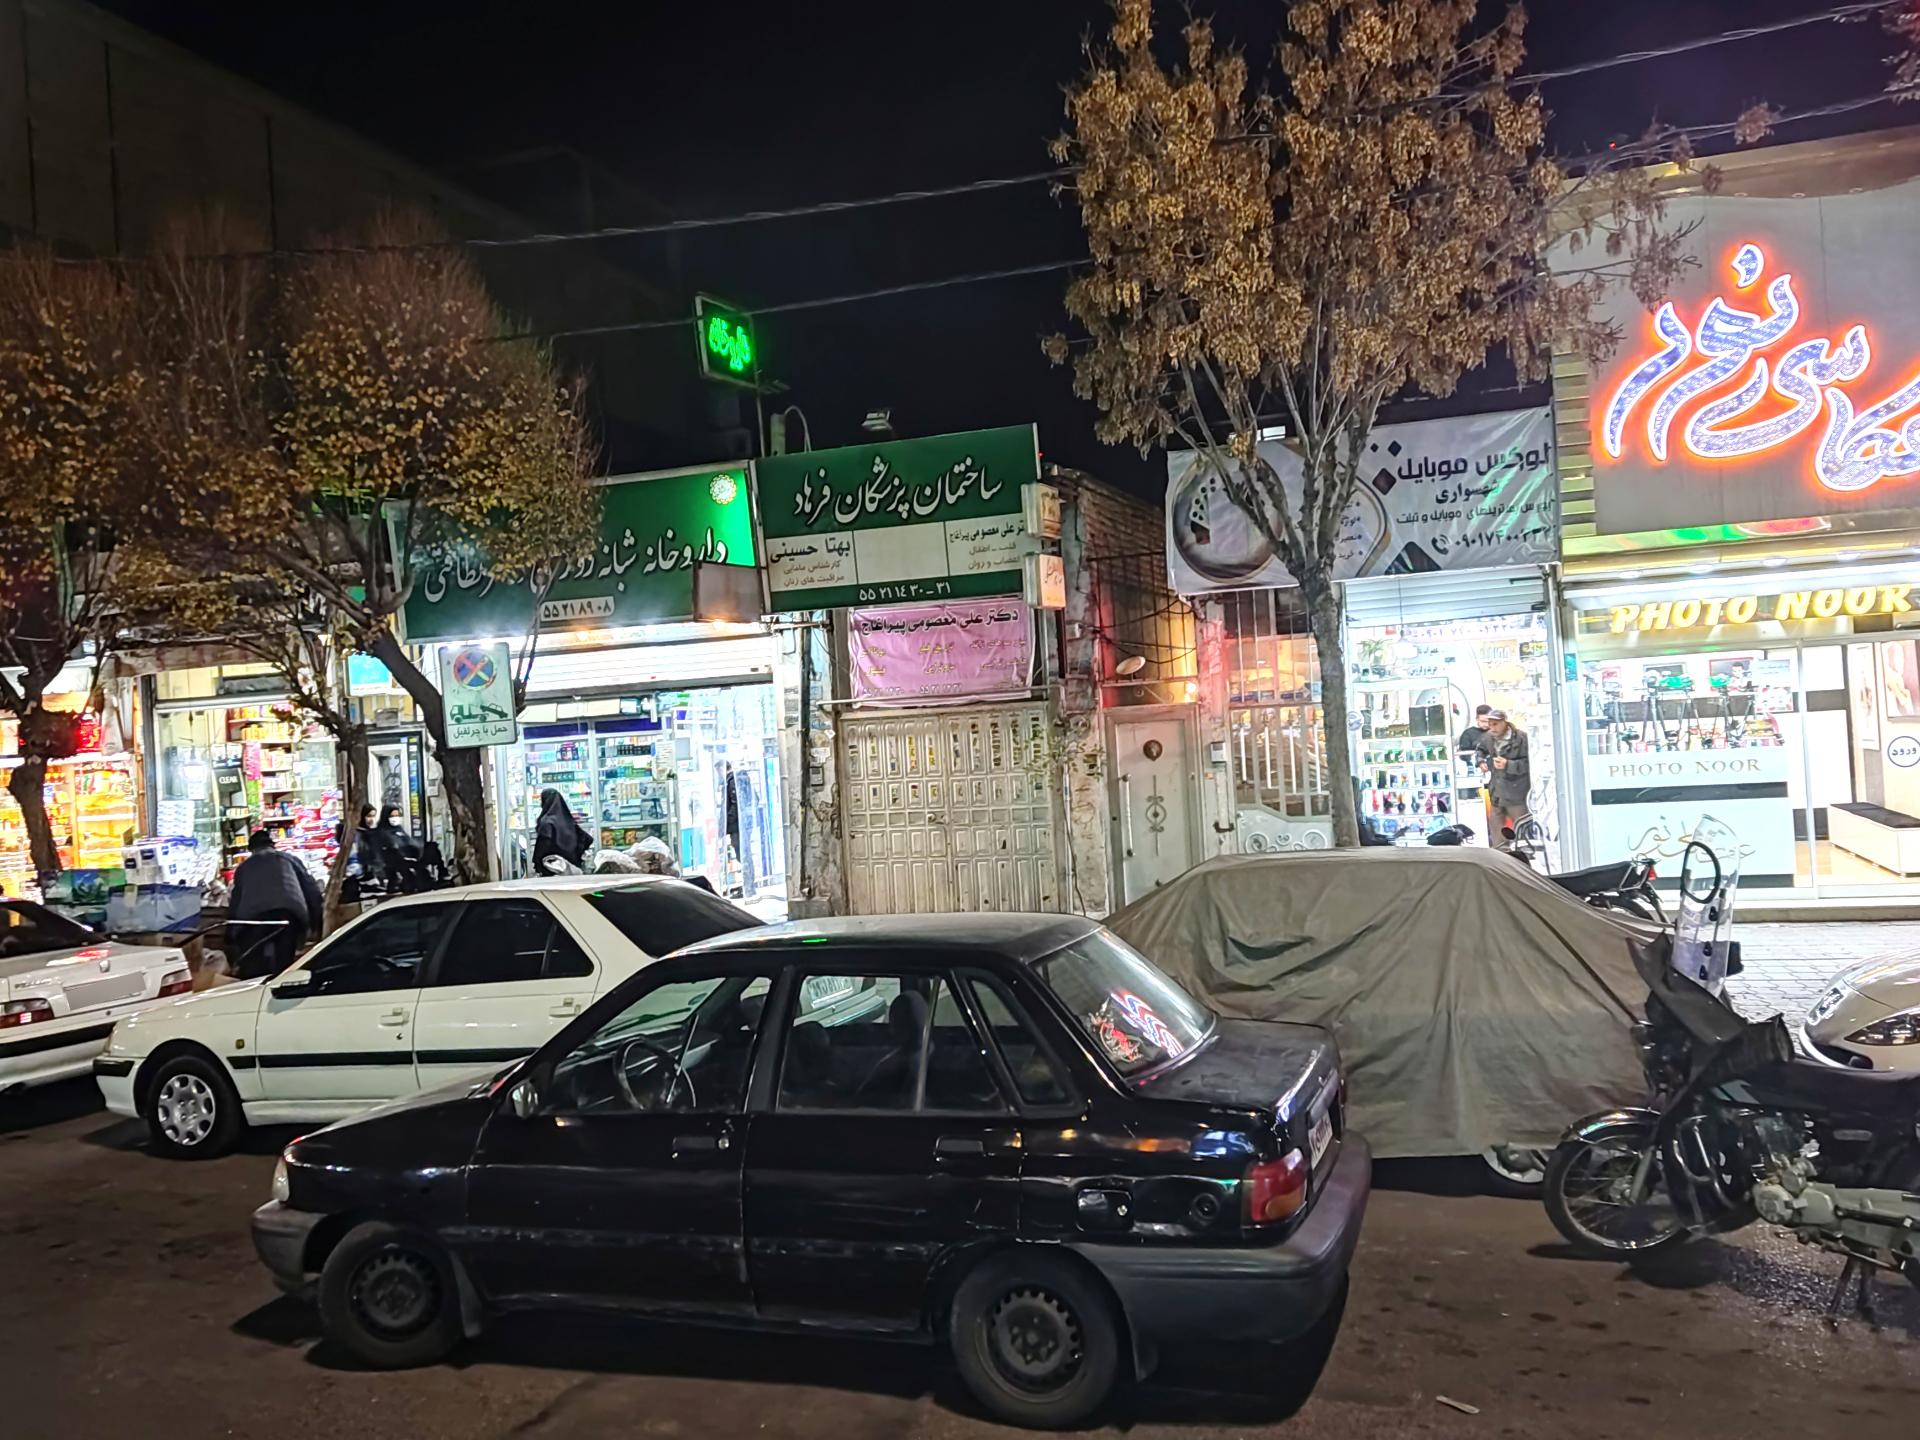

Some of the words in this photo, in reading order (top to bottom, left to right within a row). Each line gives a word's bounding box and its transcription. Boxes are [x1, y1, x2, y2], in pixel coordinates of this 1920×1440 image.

[1398, 456, 1468, 484] موبایل
[834, 455, 908, 525] پزشکان
[913, 456, 1002, 516] ساختمان
[794, 468, 831, 525] فرهاد
[598, 528, 637, 591] شبانه
[770, 542, 818, 563] حسینی
[985, 608, 1019, 626] دکتر
[1610, 595, 1758, 634] PHOTO
[1774, 584, 1913, 621] NOOR
[908, 613, 957, 632] معصومی
[959, 611, 984, 630] علی
[453, 726, 480, 739] جرثقیل
[482, 725, 489, 735] با
[491, 725, 508, 736] حمل
[1891, 747, 1917, 756] ورود
[1609, 761, 1683, 778] PHOTO
[1695, 758, 1762, 775] NOOR
